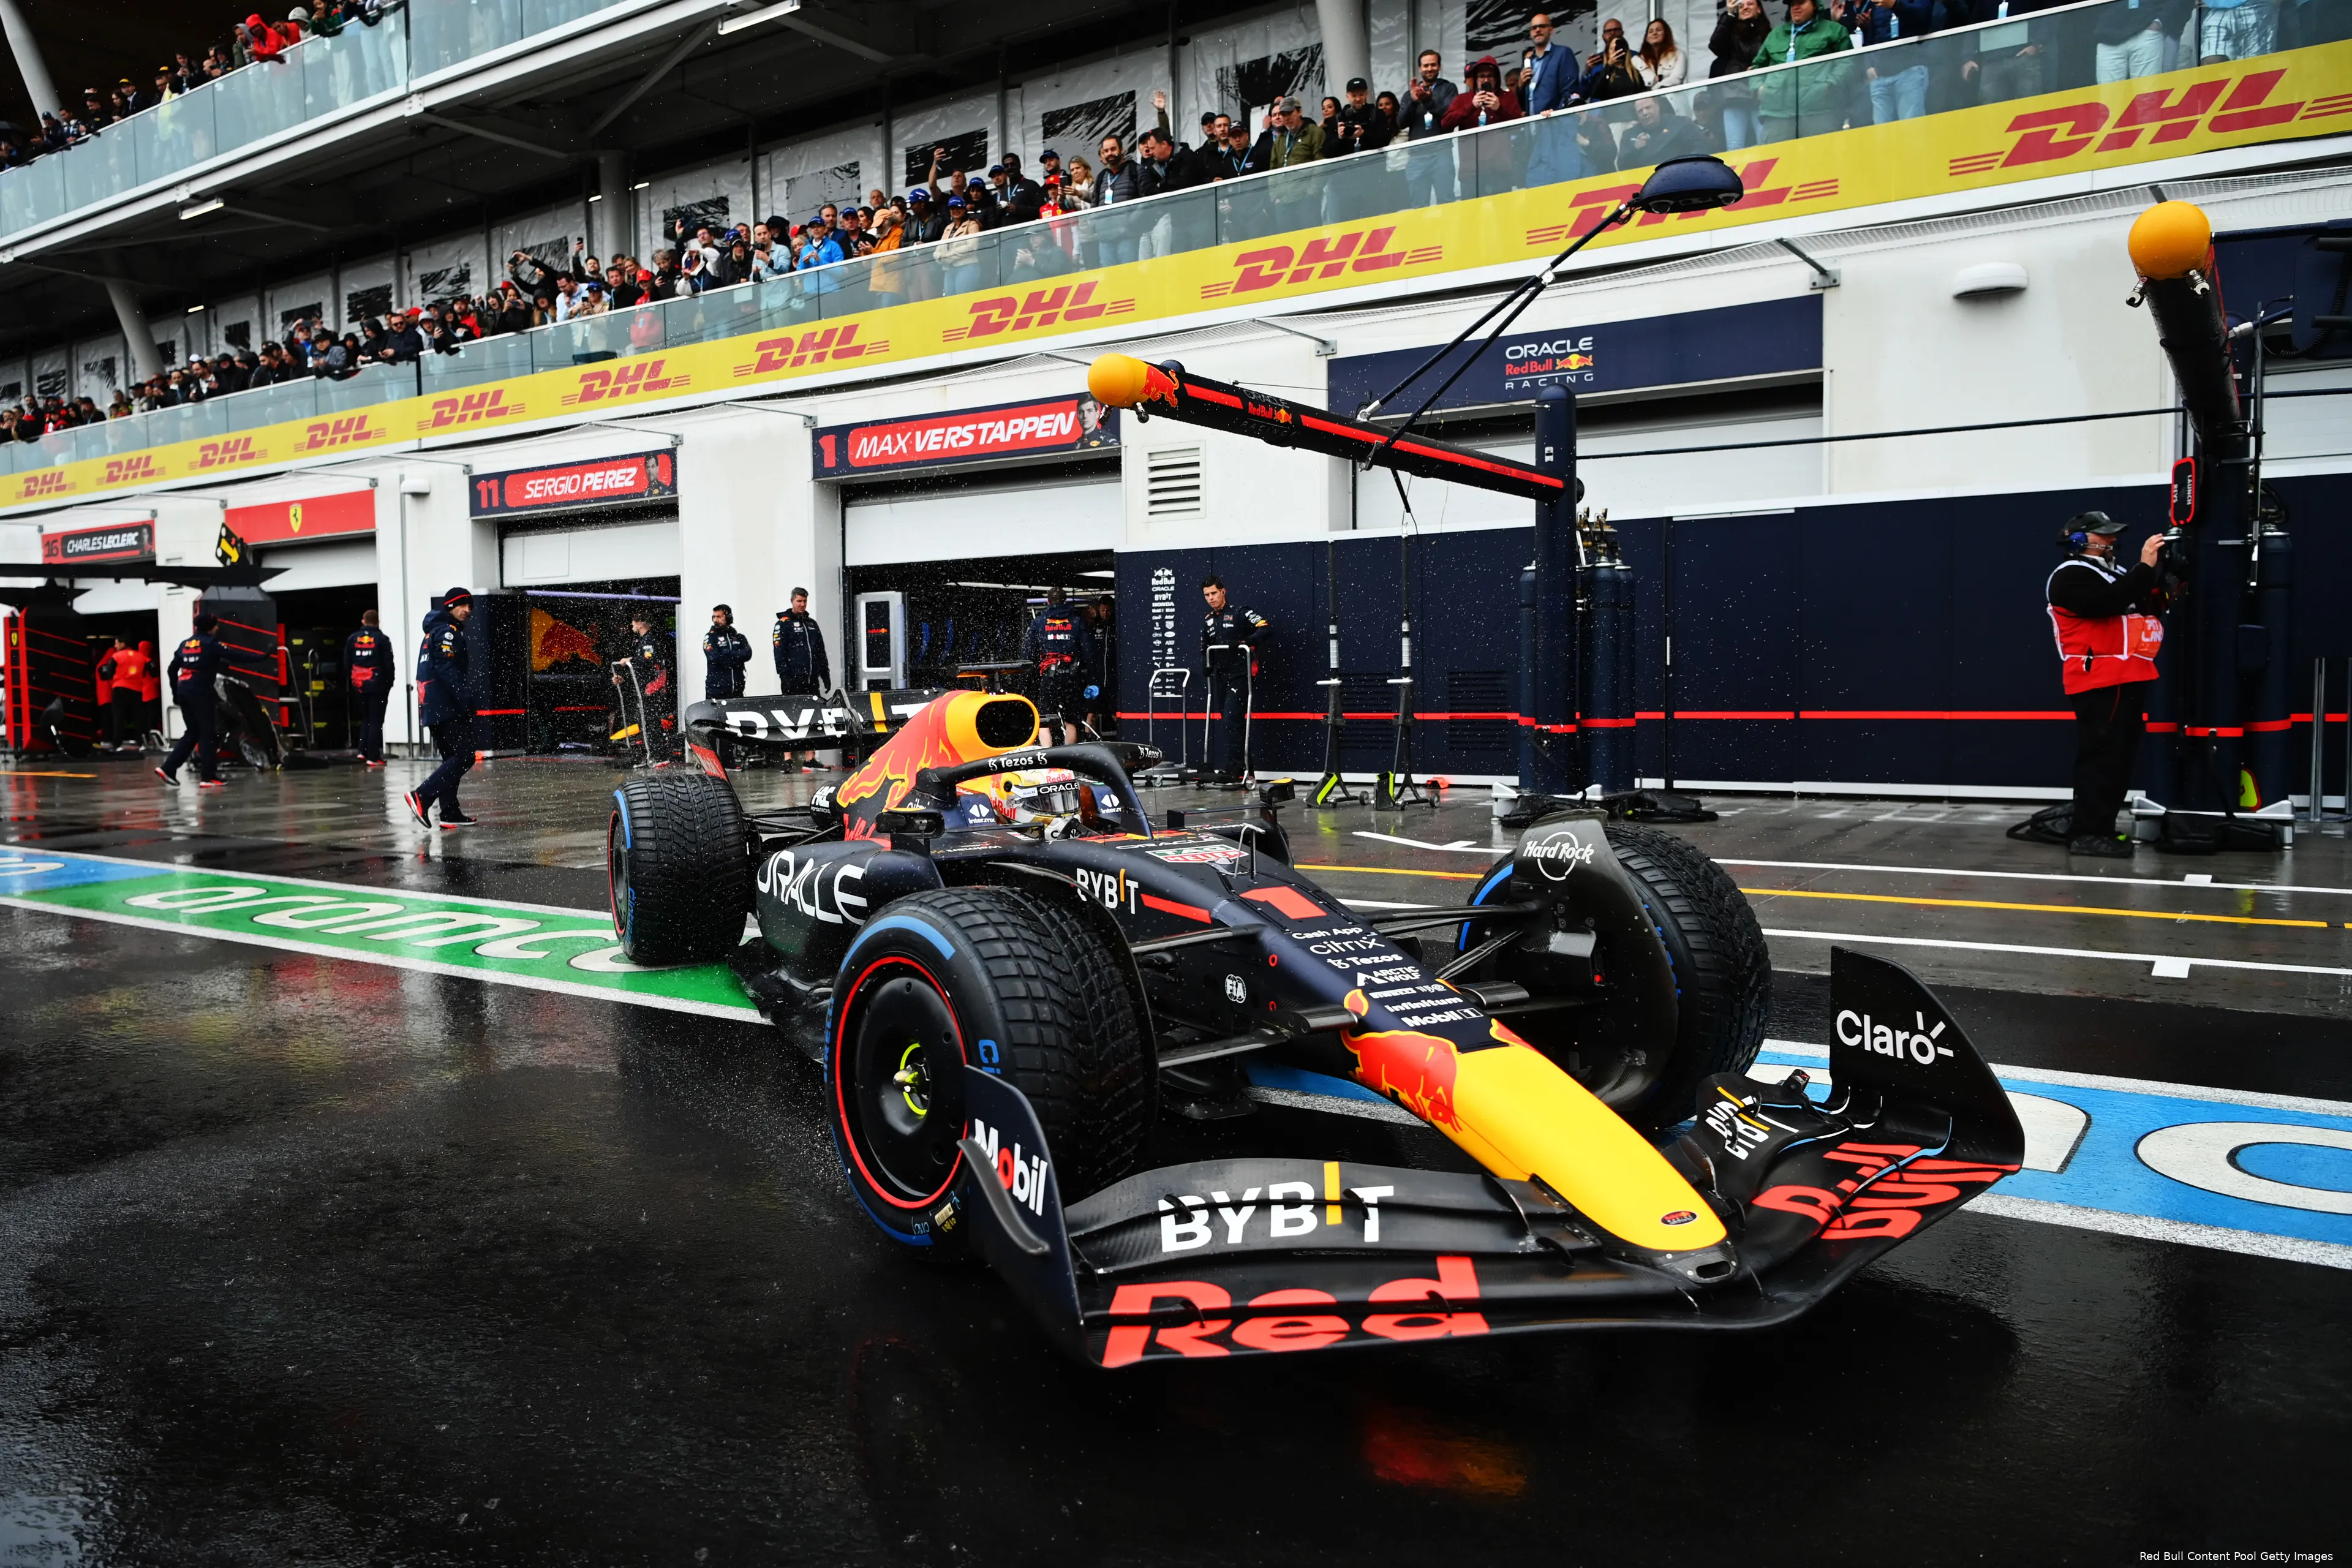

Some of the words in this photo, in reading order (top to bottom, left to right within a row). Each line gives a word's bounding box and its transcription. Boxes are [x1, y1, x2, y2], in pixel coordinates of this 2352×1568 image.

[2000, 68, 2306, 168] DHL
[1565, 158, 1792, 239] DL
[1232, 226, 1408, 293] DHL
[967, 281, 1107, 338] DHL
[753, 323, 867, 374] DHL
[1506, 337, 1593, 360] ORACLE
[1506, 361, 1528, 375] Red
[1529, 358, 1553, 372] Bull
[578, 360, 672, 404] DHL
[1506, 373, 1593, 390] RACING
[431, 389, 510, 428] DHL
[1243, 390, 1290, 409] ORACLE
[1248, 402, 1261, 418] Red
[1261, 405, 1273, 419] Bull
[307, 415, 372, 450] DHL
[819, 435, 836, 468] 1
[855, 432, 911, 458] MAX
[914, 412, 1076, 451] VERSTAPPEN
[1240, 421, 1287, 436] RACING
[199, 437, 256, 468] DHL
[105, 456, 156, 483] DHL
[23, 471, 67, 497] DHL
[477, 479, 500, 508] 11
[524, 474, 581, 499] SERGIO
[582, 466, 637, 491] PEREZ
[44, 539, 59, 558] 16
[67, 535, 104, 554] CHARLES
[102, 531, 139, 549] LECLERC
[1154, 592, 1172, 601] BYBIT
[2141, 631, 2163, 643] LAN
[1000, 756, 1034, 769] Tezos
[1039, 782, 1079, 794] ORACLE
[1046, 774, 1061, 783] Red
[1116, 837, 1224, 850] ORACLE
[1156, 846, 1227, 855] TAG
[1523, 840, 1560, 859] Hard
[1558, 842, 1594, 864] Rock
[1239, 886, 1327, 919] 1
[1292, 929, 1330, 940] Cash
[1332, 925, 1363, 936] App
[1348, 954, 1403, 966] Tezos
[1373, 966, 1420, 978] ARCTIC
[1385, 972, 1421, 982] WOLF
[1226, 979, 1245, 999] FIA
[1384, 997, 1463, 1012] infinitum
[1401, 1011, 1463, 1027] Mobil
[1836, 1009, 1939, 1065] Claro
[974, 1118, 1048, 1216] Mobil
[1158, 1161, 1395, 1253] BYBIT
[1102, 1256, 1490, 1368] Red
